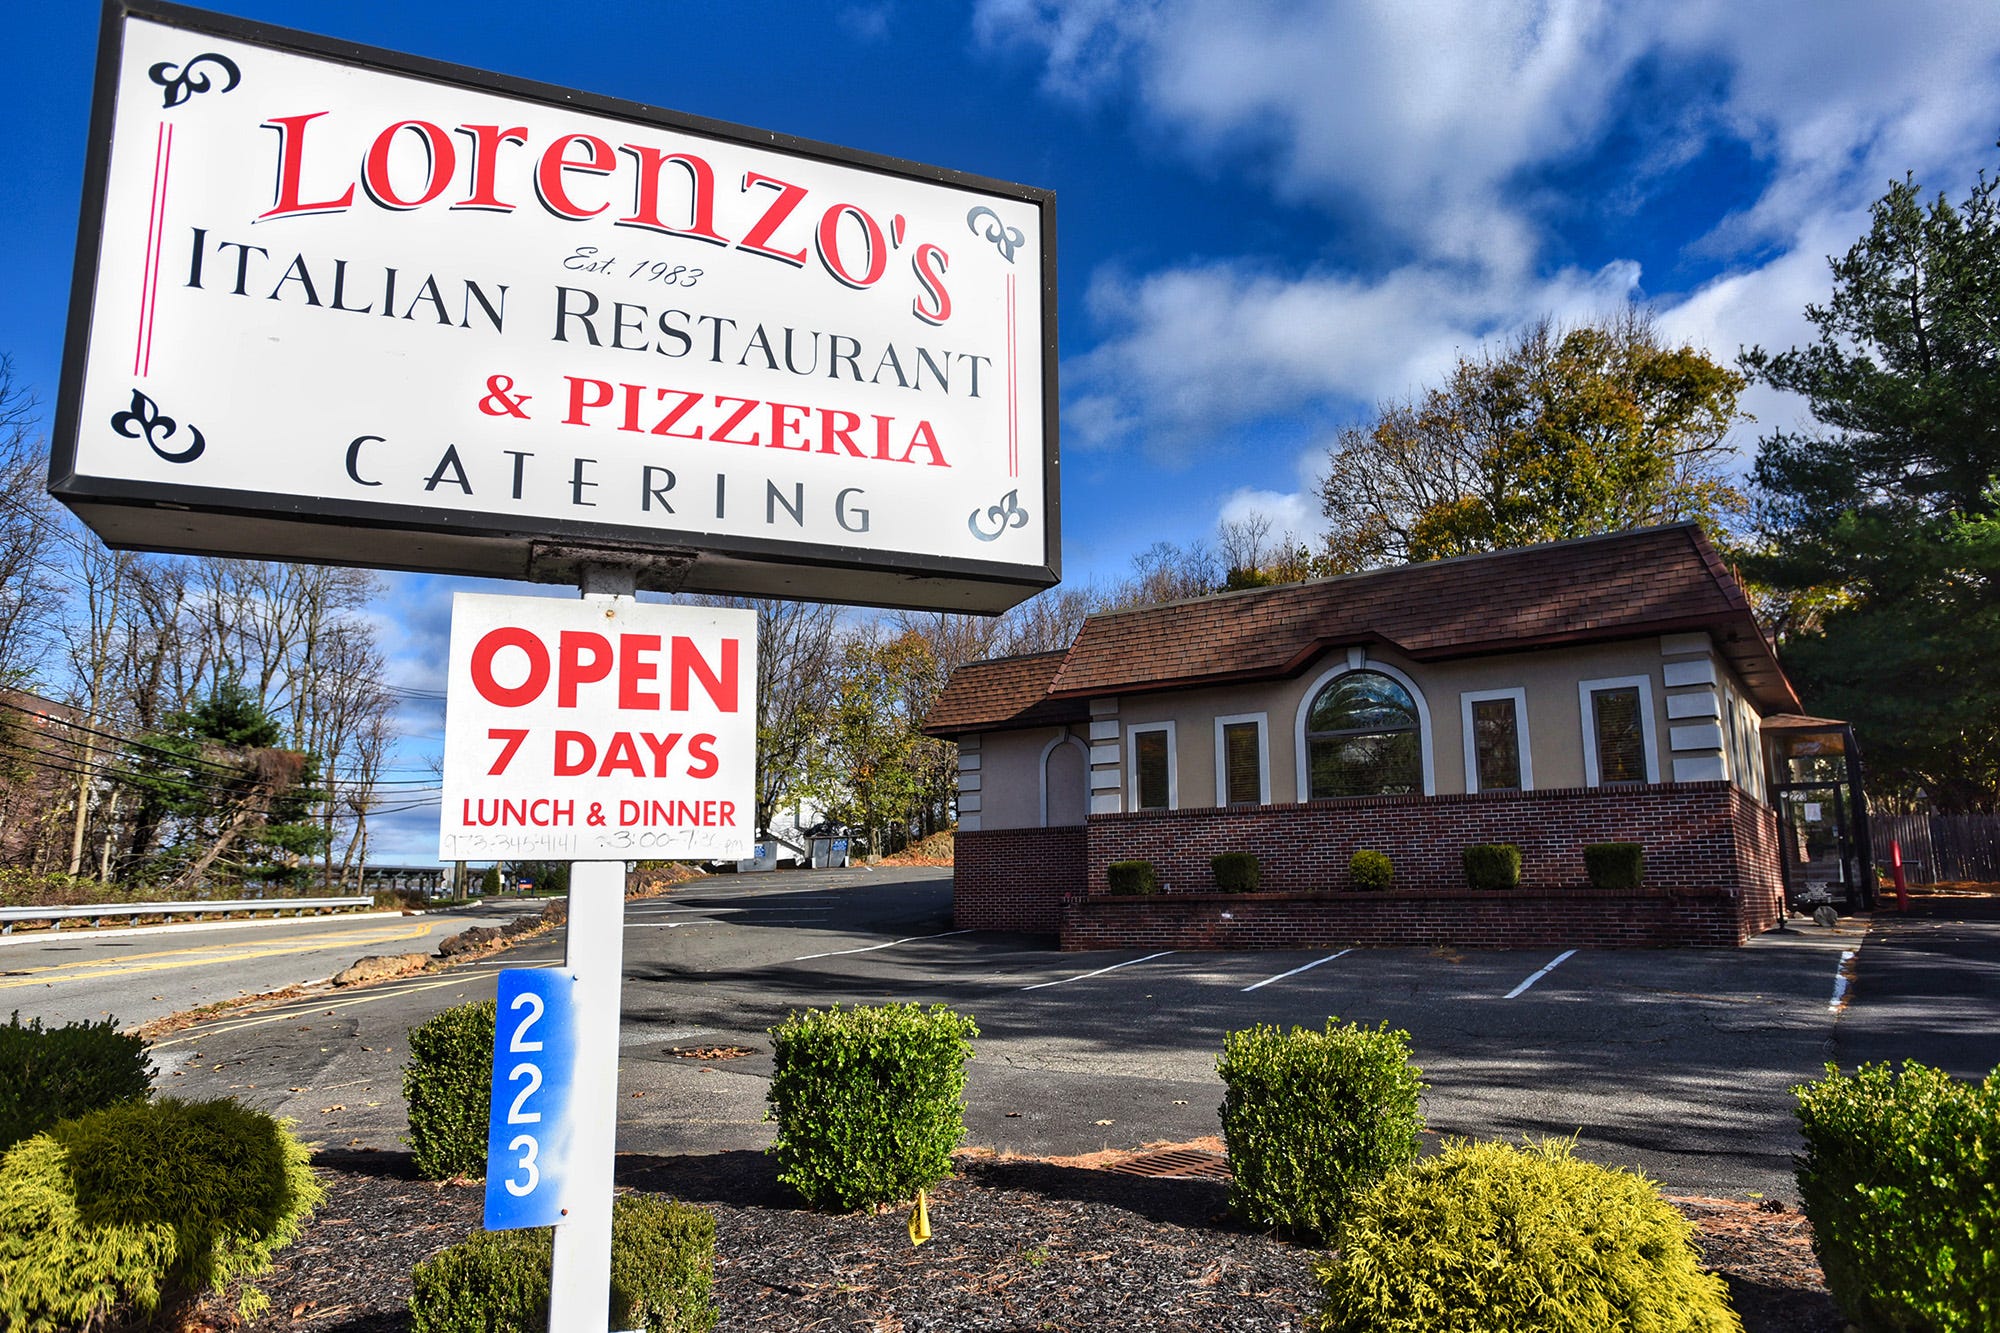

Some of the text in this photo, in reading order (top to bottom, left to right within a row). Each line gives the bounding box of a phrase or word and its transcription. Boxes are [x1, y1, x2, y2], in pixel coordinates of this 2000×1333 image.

[251, 111, 952, 326] Lorenzo's
[183, 226, 993, 398] ITALIAN RESTAURANT
[563, 246, 704, 287] Est. 1983
[478, 374, 952, 468] & PIZZERIA
[345, 434, 870, 534] CATERING
[470, 626, 739, 713] OPEN
[487, 728, 719, 780] 7 DAYS
[462, 798, 736, 827] LUNCH & DINNER
[504, 992, 545, 1197] 223
